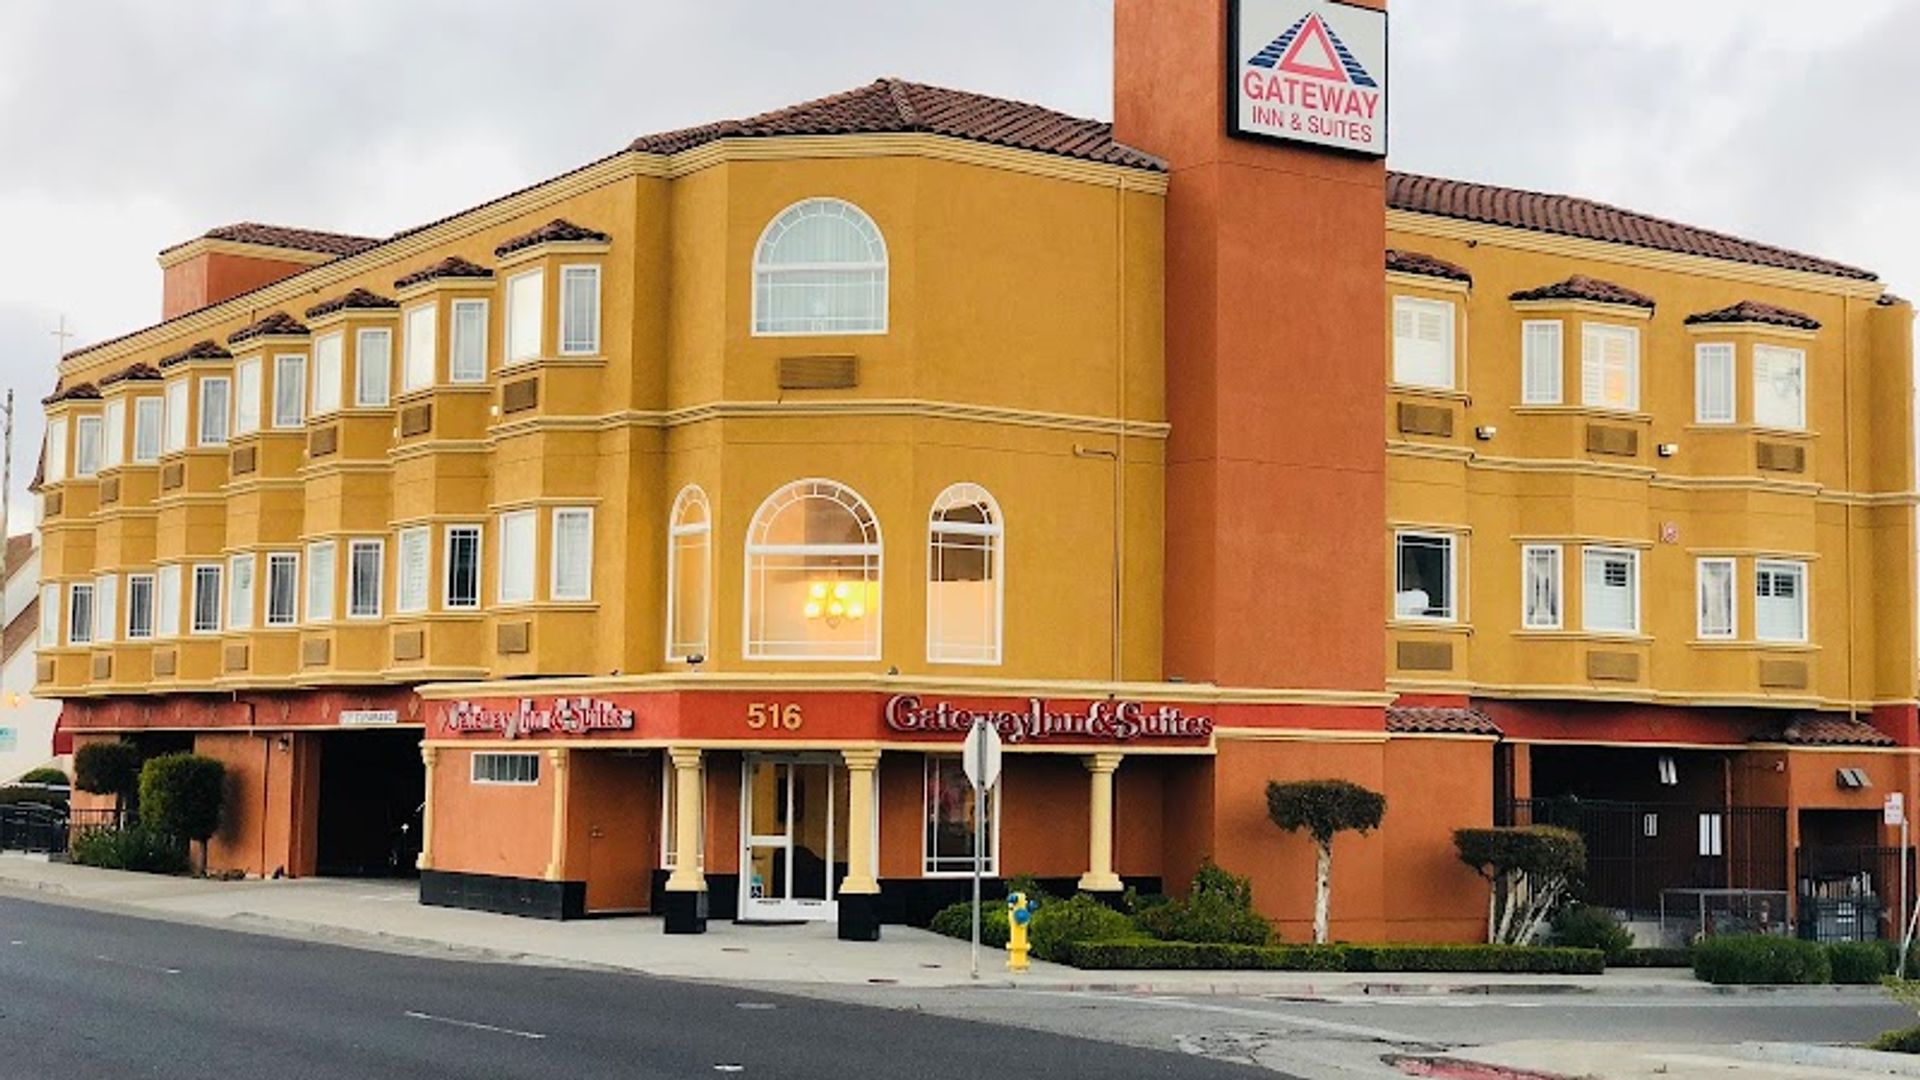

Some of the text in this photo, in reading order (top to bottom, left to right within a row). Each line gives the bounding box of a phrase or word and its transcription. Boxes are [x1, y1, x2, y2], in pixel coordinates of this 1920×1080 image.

[1243, 69, 1379, 119] GATEWAY
[1252, 105, 1373, 143] INN & SUITES
[747, 702, 803, 731] 516
[1029, 697, 1088, 736] Inn
[1085, 700, 1118, 735] &
[1114, 701, 1214, 739] Suites
